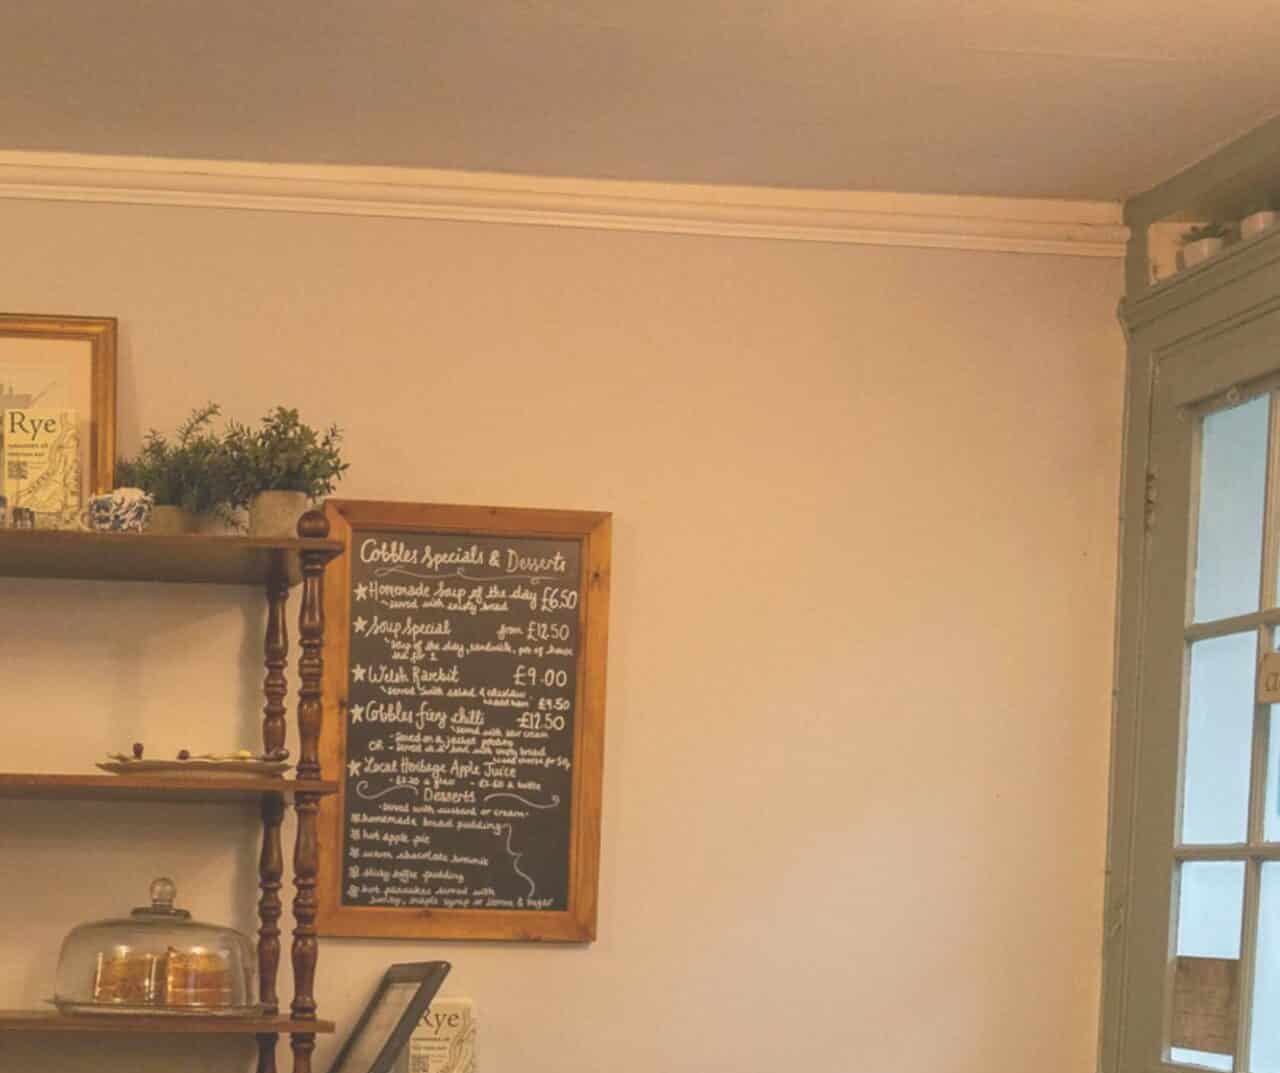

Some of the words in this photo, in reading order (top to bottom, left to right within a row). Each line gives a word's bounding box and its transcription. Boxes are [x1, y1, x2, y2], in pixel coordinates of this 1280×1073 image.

[8, 411, 56, 440] Rye
[360, 538, 418, 564] Cobbles
[421, 544, 484, 572] Specials
[488, 549, 500, 568] &
[506, 548, 567, 573] Desserts
[422, 598, 444, 608] with
[467, 585, 483, 604] of
[485, 584, 506, 599] the
[509, 585, 537, 610] day
[402, 616, 451, 641] Special
[368, 664, 410, 683] Welsh
[513, 664, 568, 688] £9.00
[365, 700, 414, 723] Cobbles
[364, 756, 399, 774] Local
[450, 760, 480, 778] Apple
[483, 761, 517, 778] Juice
[423, 787, 475, 803] Desserts
